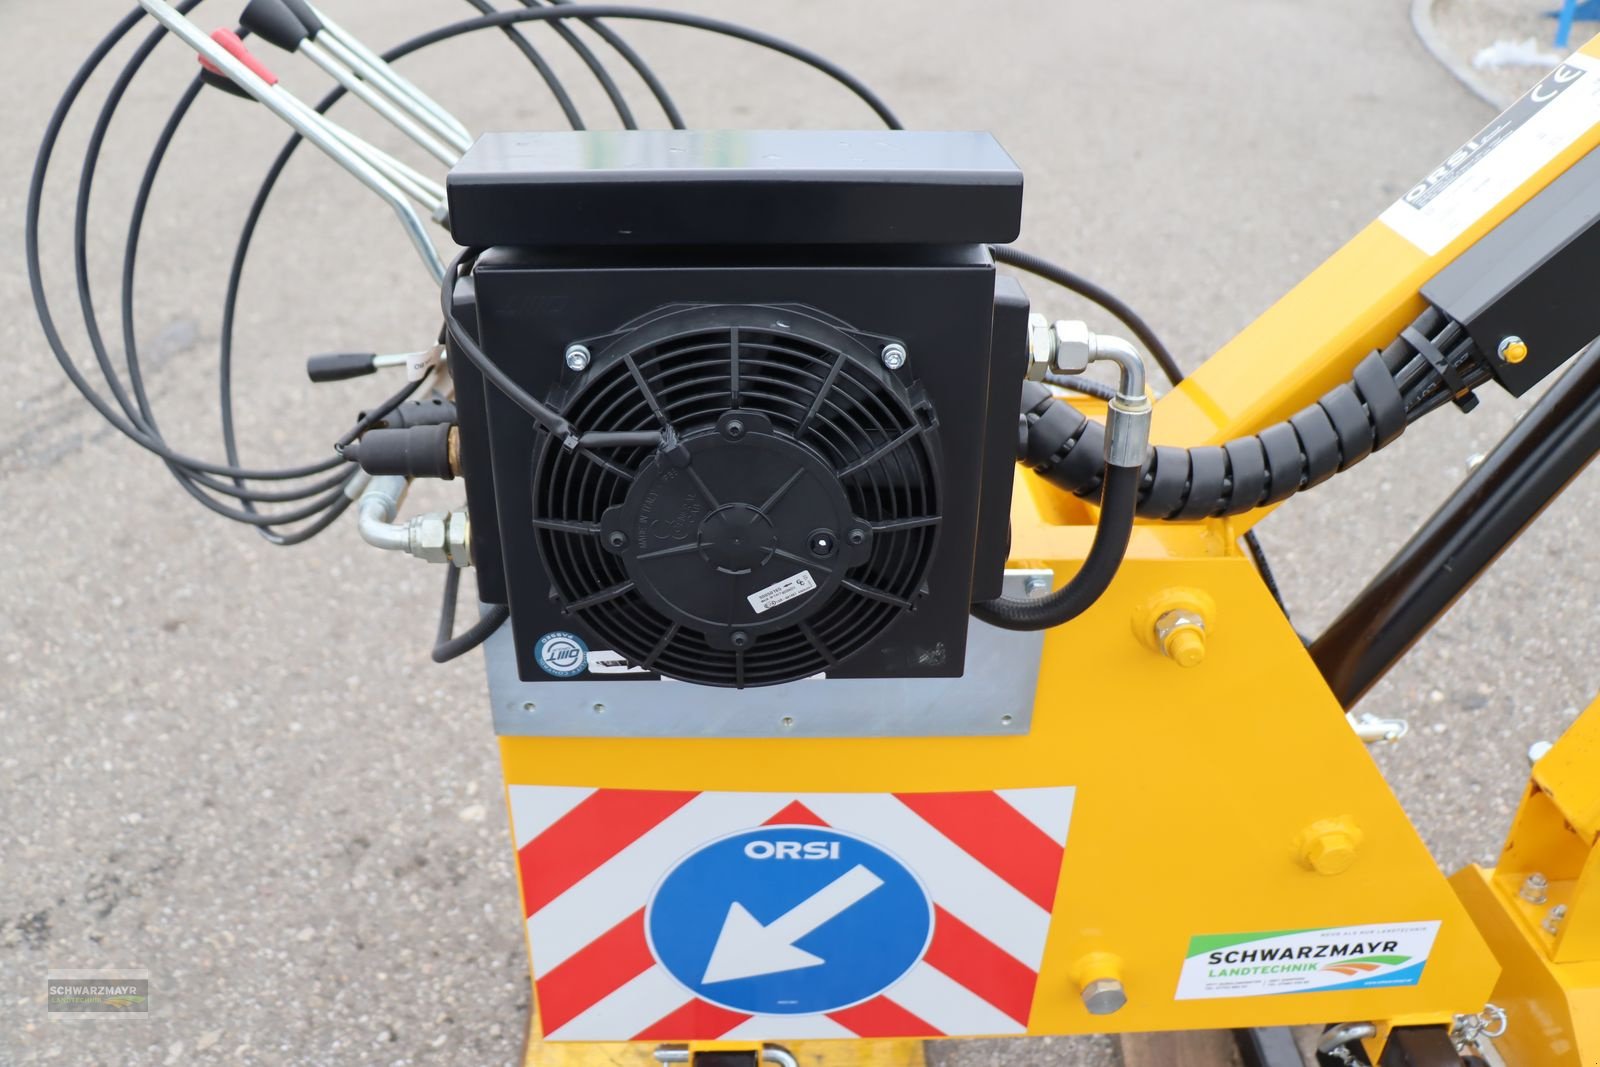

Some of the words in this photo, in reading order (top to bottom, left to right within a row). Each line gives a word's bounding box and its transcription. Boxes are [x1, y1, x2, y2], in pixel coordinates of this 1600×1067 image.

[1405, 140, 1481, 203] ORSI
[743, 840, 841, 860] ORSI
[1208, 940, 1399, 965] SCHWARZMAYR
[1208, 962, 1318, 978] LANDTECHNIK
